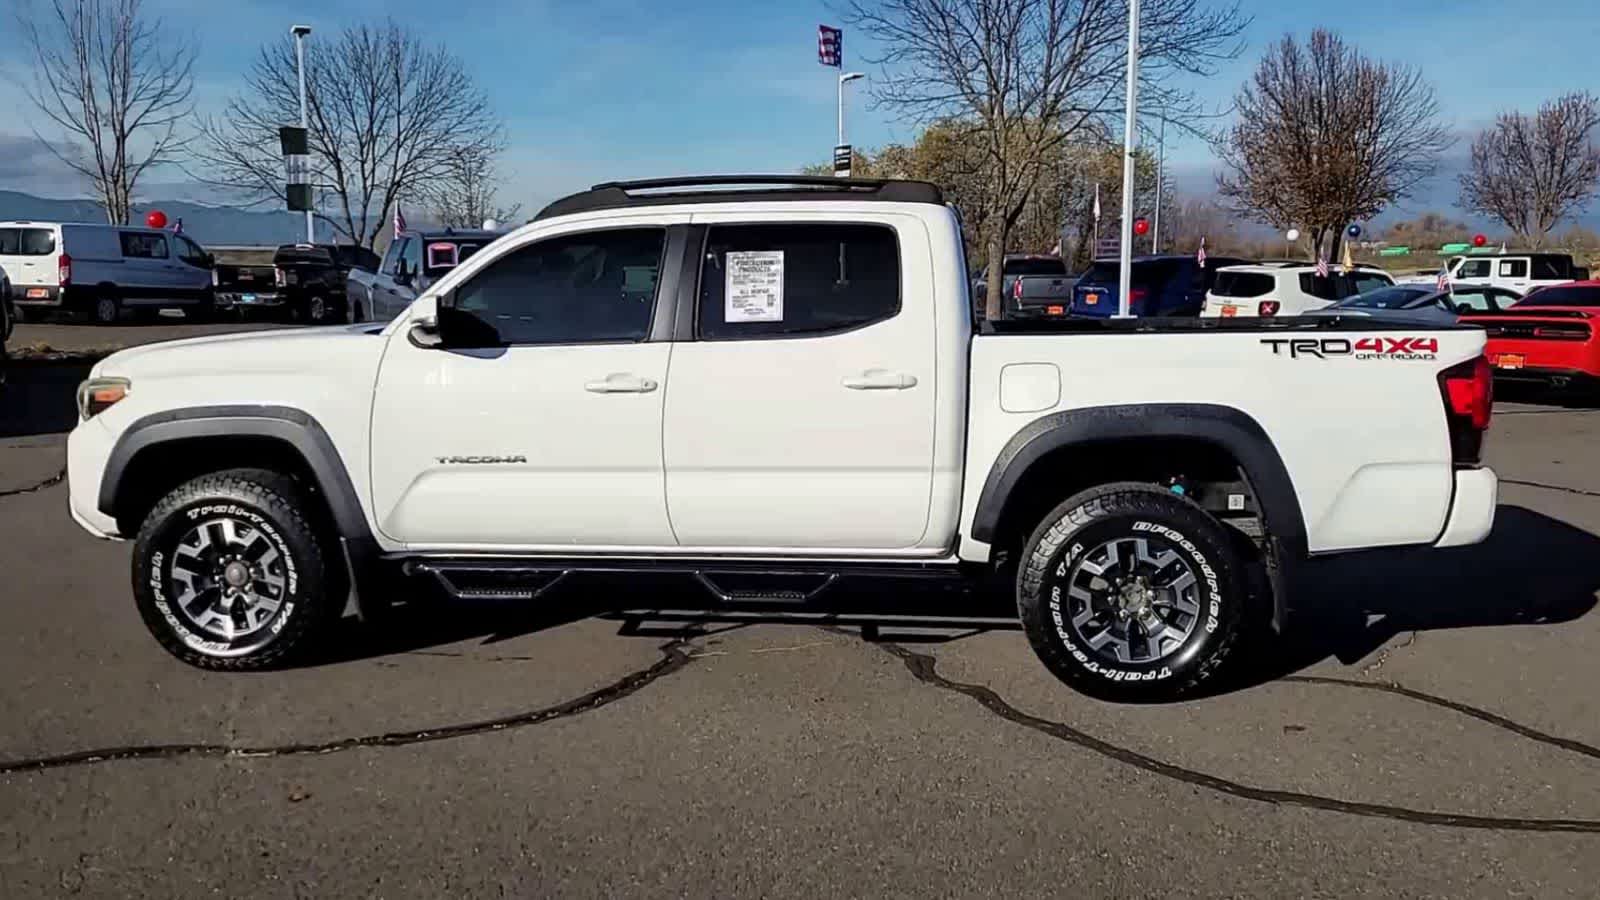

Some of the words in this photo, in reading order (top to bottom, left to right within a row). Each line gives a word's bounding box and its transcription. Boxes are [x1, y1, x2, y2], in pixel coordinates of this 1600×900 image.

[1260, 338, 1351, 359] TRD
[435, 455, 528, 464] TACOMA
[1056, 542, 1084, 578] T/A
[1132, 521, 1222, 633] BFGoodrich
[271, 601, 295, 635] T/A
[1049, 585, 1173, 682] Trail-Terrain
